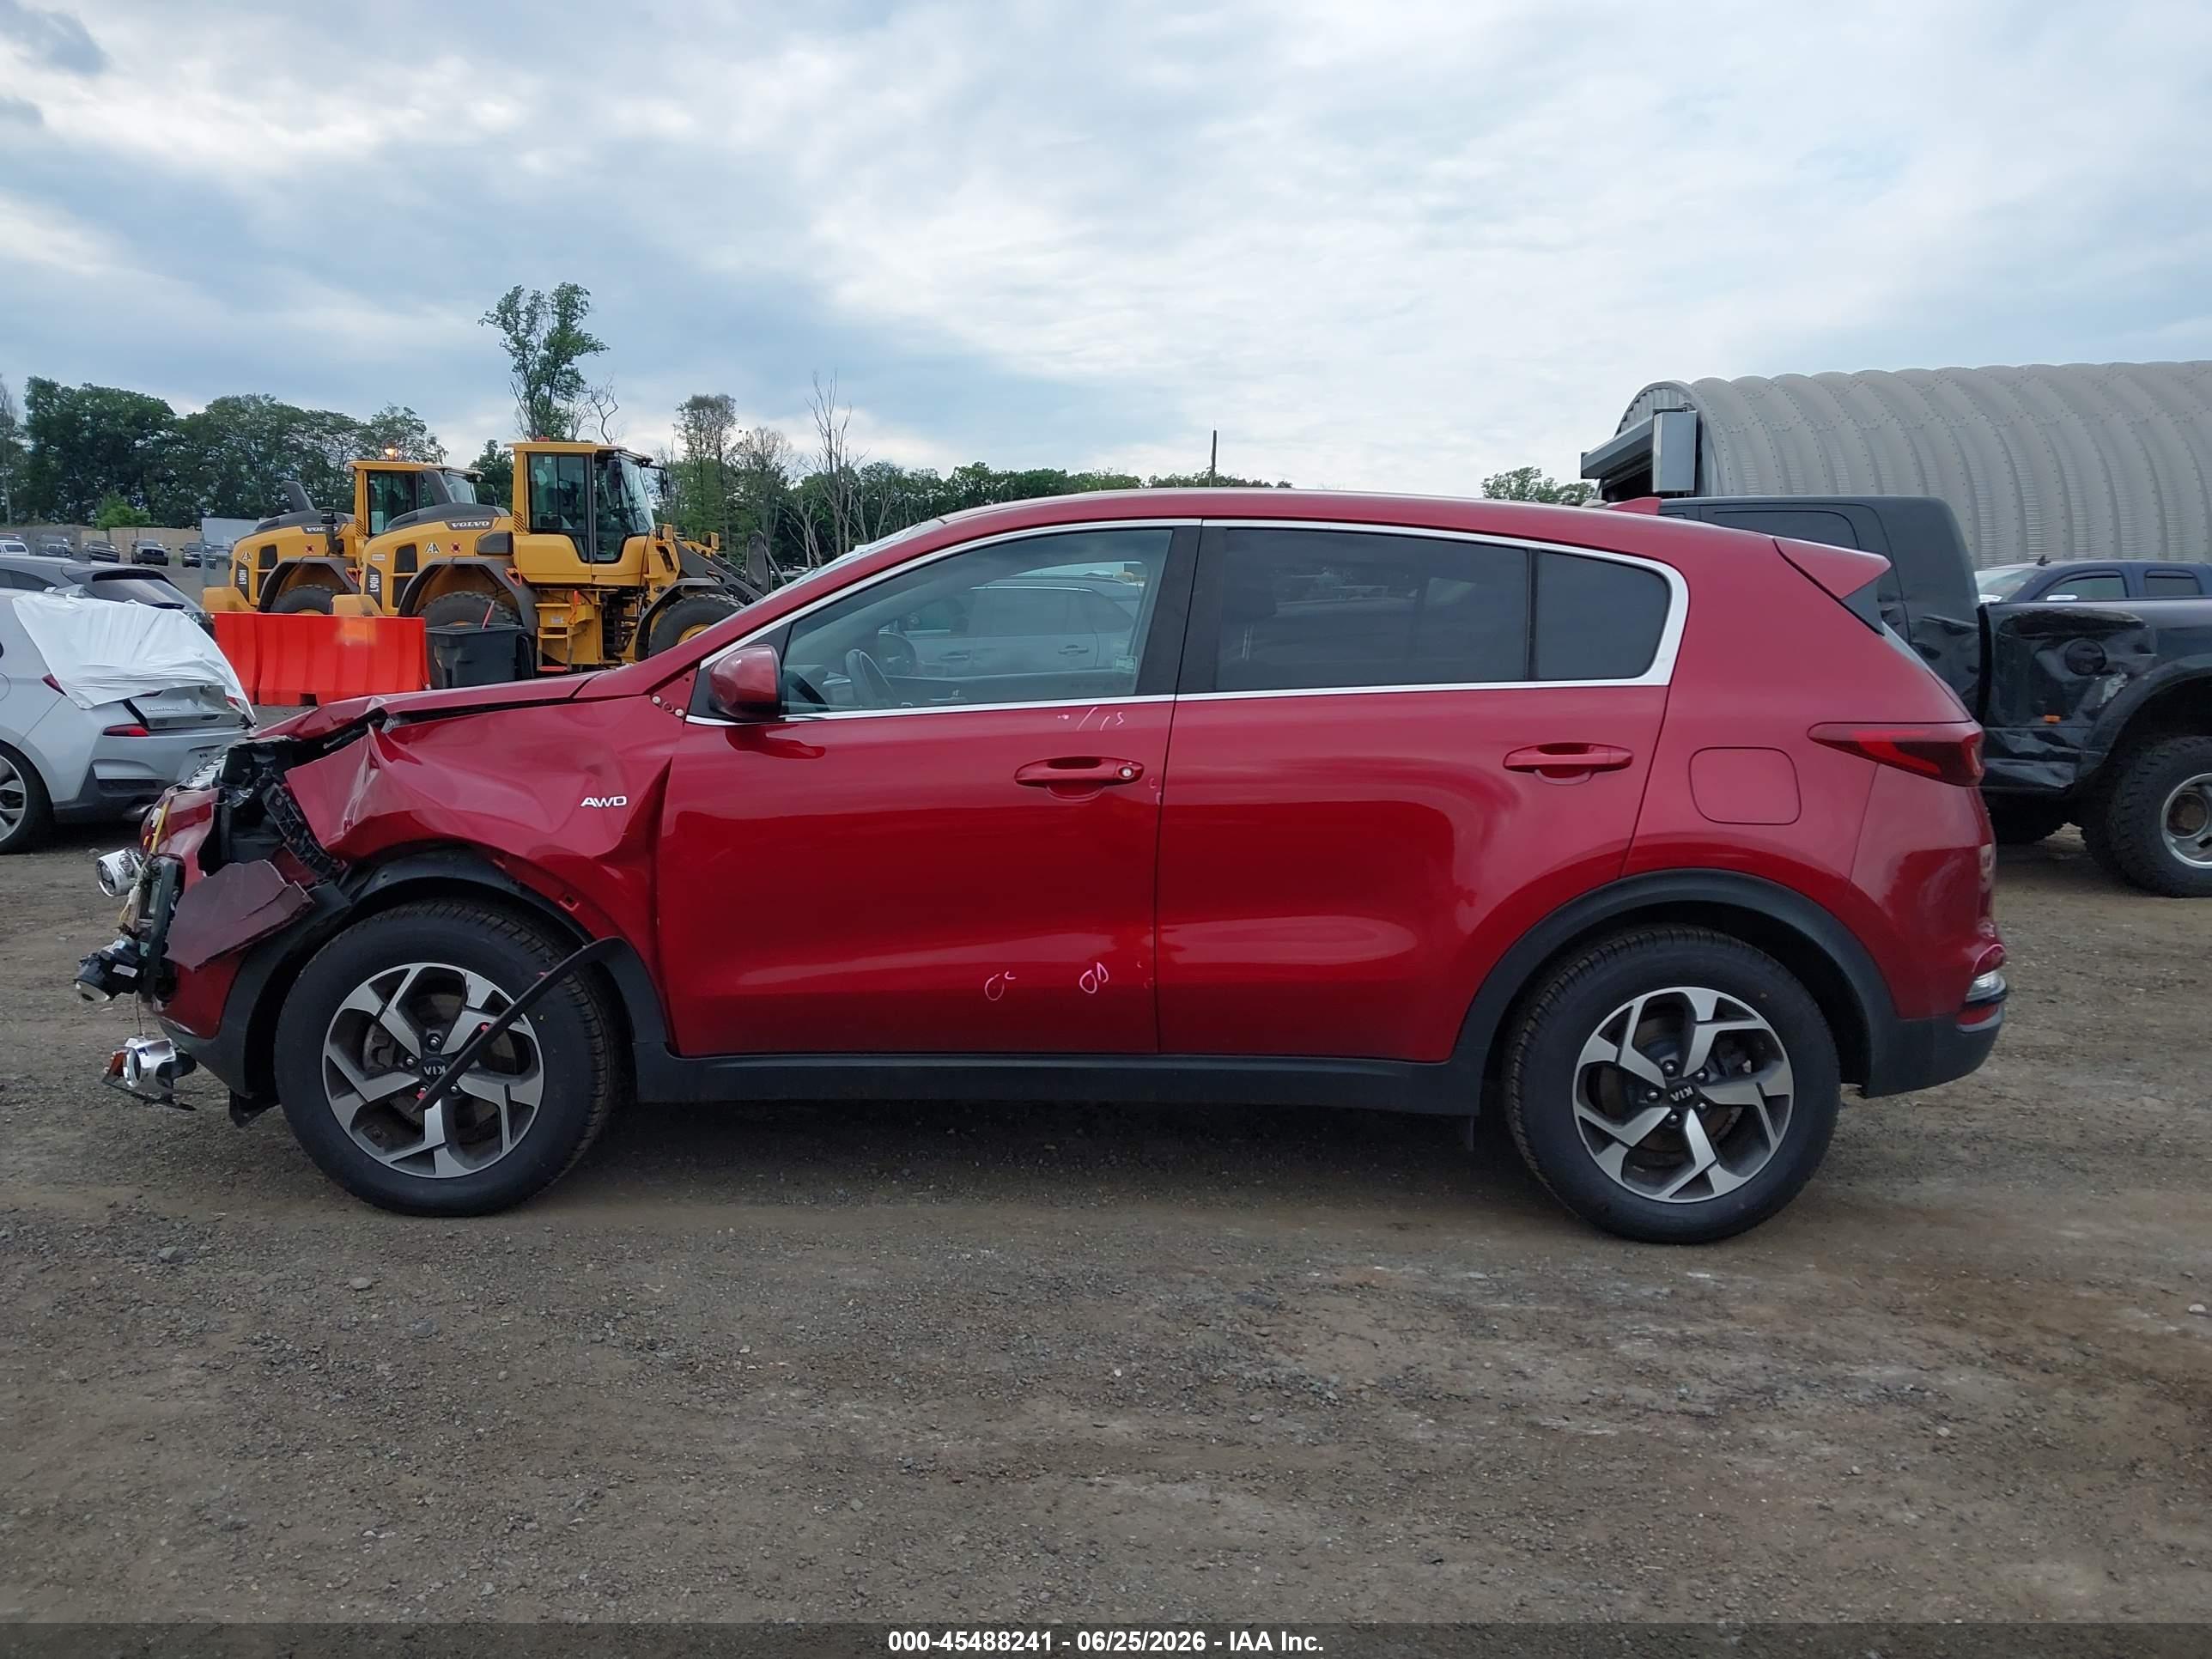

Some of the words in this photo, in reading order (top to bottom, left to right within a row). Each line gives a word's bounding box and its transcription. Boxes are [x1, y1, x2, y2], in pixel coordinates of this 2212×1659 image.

[369, 574, 380, 592] L90H
[580, 795, 627, 808] AWD
[423, 1065, 447, 1076] KIA
[1669, 1085, 1693, 1102] KIA
